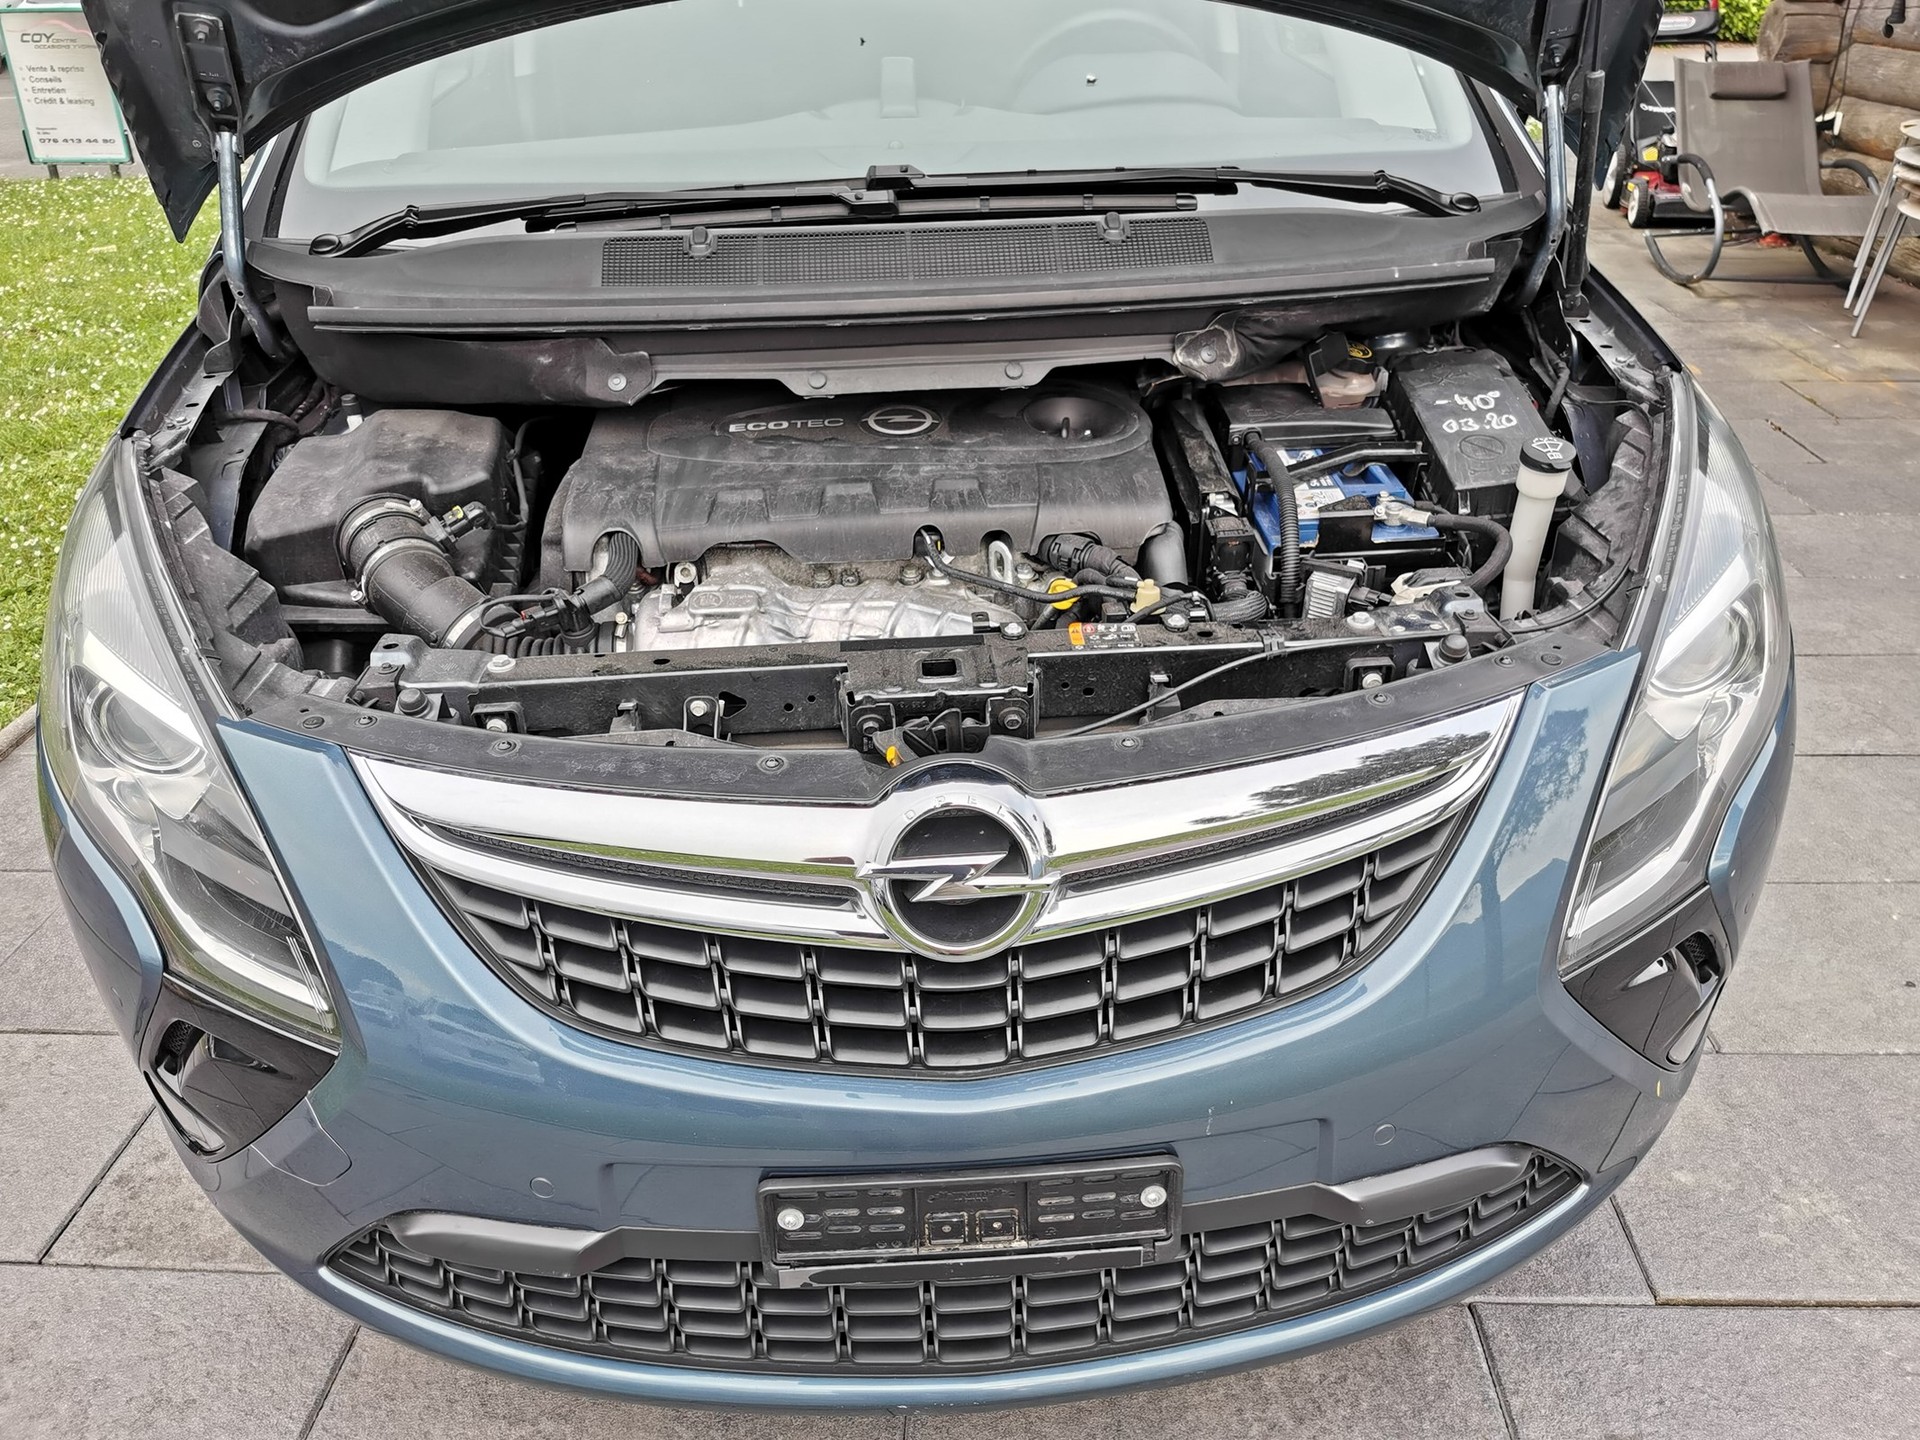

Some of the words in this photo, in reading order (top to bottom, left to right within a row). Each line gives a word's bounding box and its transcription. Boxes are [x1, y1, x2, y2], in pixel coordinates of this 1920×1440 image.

[21, 32, 55, 43] COY
[58, 65, 84, 74] reprise
[29, 75, 62, 83] Conseils
[31, 86, 66, 94] Entretien
[67, 97, 95, 106] leasing
[728, 418, 844, 433] ECOTEC
[904, 794, 1006, 820] OPEL
